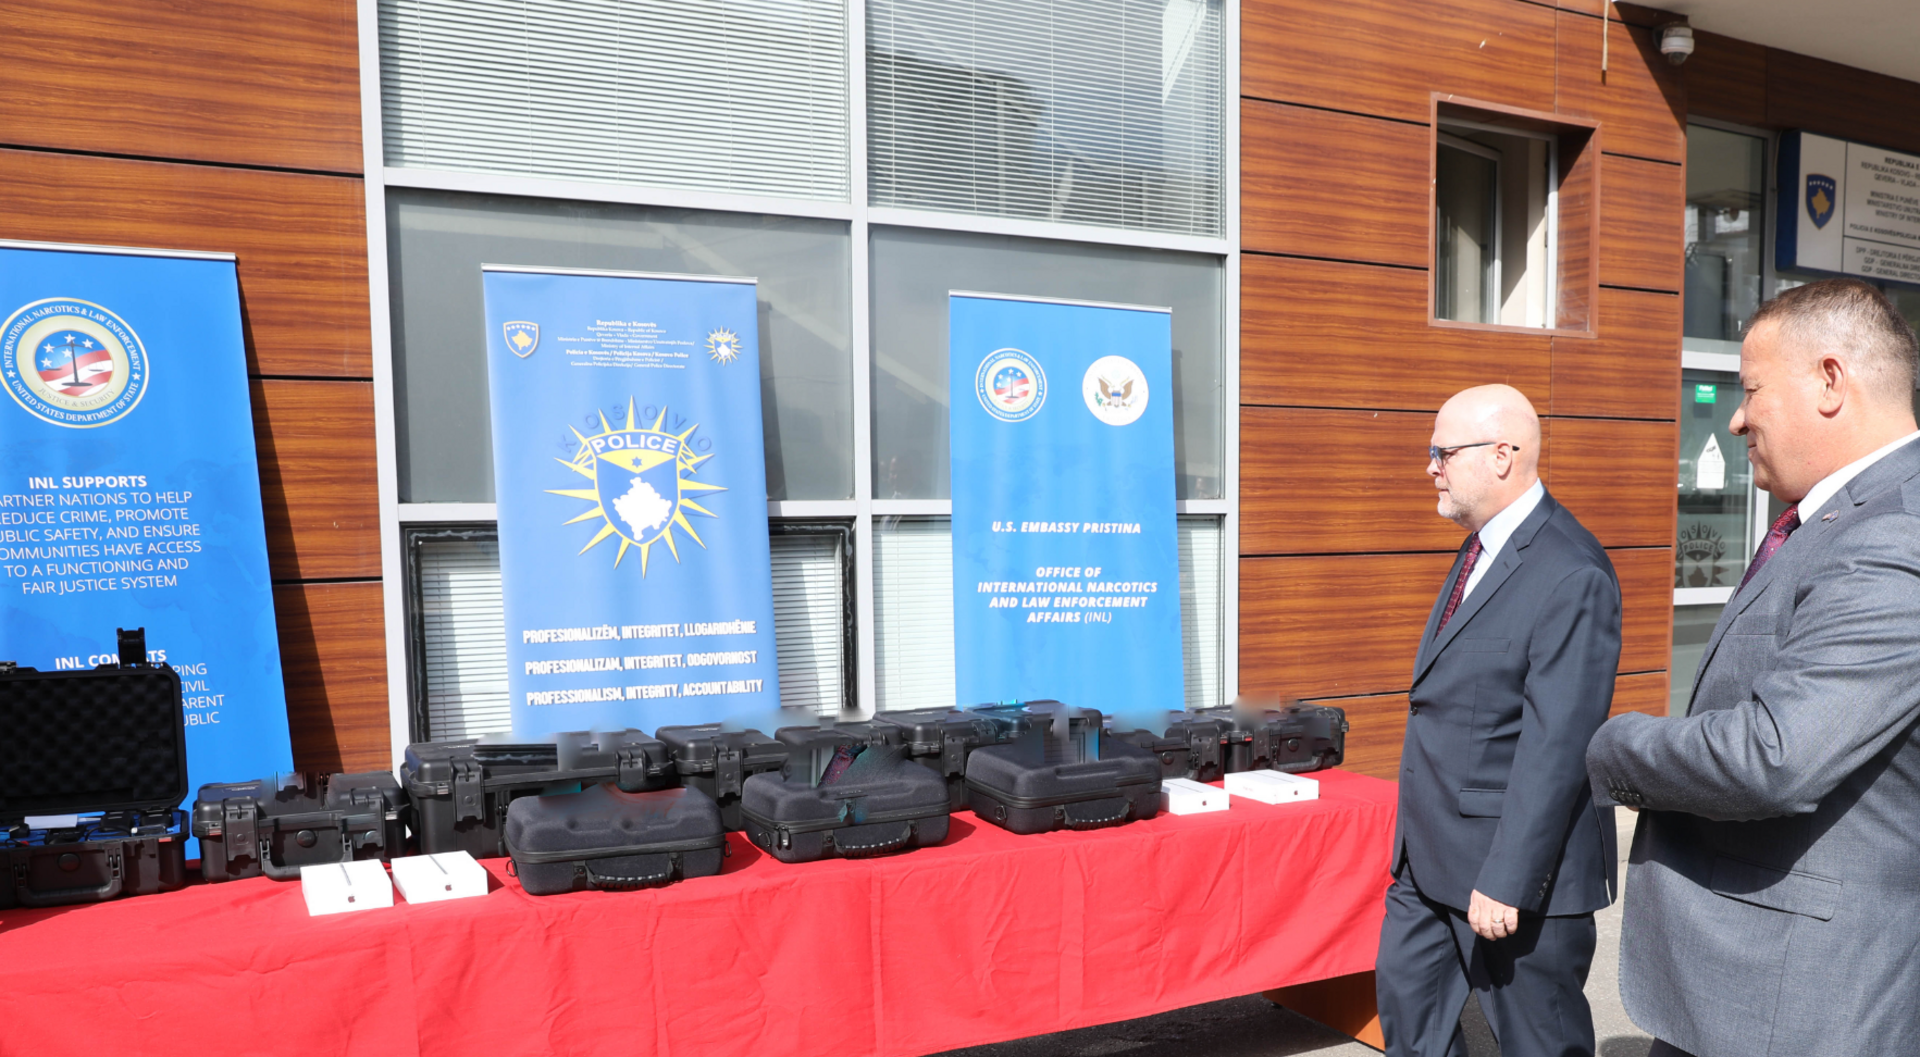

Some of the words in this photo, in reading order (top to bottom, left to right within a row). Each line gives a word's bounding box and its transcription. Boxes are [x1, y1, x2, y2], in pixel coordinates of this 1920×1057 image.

[3, 314, 35, 369] INTERNATIONAL
[32, 305, 80, 319] NARCOTICS
[88, 310, 108, 323] LAW
[105, 319, 141, 371] ENFORCEMENT
[12, 379, 37, 406] UNITED
[35, 402, 65, 419] STATES
[65, 405, 117, 422] DEPARTMENT
[116, 399, 127, 410] OF
[123, 382, 140, 402] STATE
[38, 387, 71, 407] JUSTICE
[80, 388, 116, 407] SECURITY
[591, 434, 678, 454] POLICE
[29, 476, 59, 489] INL
[62, 475, 148, 488] SUPPORTS
[59, 492, 127, 506] NATIONS
[130, 492, 151, 504] TO
[155, 491, 193, 504] HELP
[0, 511, 56, 525] EDUCE
[60, 510, 112, 525] CRIME,
[116, 507, 189, 522] PROMOTE
[44, 527, 103, 542] SAFETY,
[106, 526, 139, 539] AND
[144, 523, 201, 538] ENSURE
[992, 521, 1017, 532] U.S.
[1020, 521, 1080, 533] EMBASSY
[1082, 522, 1141, 534] PRISTINA
[1680, 524, 1726, 549] OSOVO
[0, 545, 100, 560] OMMUNITIES
[104, 542, 143, 556] HAVE
[147, 540, 202, 554] ACCESS
[1683, 541, 1714, 552] POLICE
[4, 564, 27, 578] TO
[31, 564, 43, 577] A
[46, 559, 153, 576] FUNCTIONING
[157, 558, 189, 571] AND
[1035, 566, 1081, 578] OFFICE
[1084, 566, 1102, 578] OF
[22, 581, 57, 594] FAIR
[58, 577, 117, 595] JUSTICE
[121, 575, 178, 590] SYSTEM
[977, 582, 1083, 593] INTERNATIONAL
[1086, 582, 1158, 593] NARCOTICS
[989, 597, 1018, 608] AND
[1021, 597, 1051, 608] LAW
[1053, 596, 1148, 608] ENFORCEMENT
[1026, 612, 1081, 623] AFFAIRS
[1084, 611, 1112, 624] (INL)
[621, 623, 684, 640] INTEGRITET,
[55, 656, 85, 670] INL
[525, 656, 624, 675] PROFESIONALIZAM,
[624, 653, 687, 670] INTEGRITET,
[687, 650, 757, 667] ODGOVORNOST
[526, 687, 625, 706] PROFESSIONALISM,
[625, 683, 682, 699] INTEGRITY,
[682, 679, 763, 697] ACCOUNTABILITY
